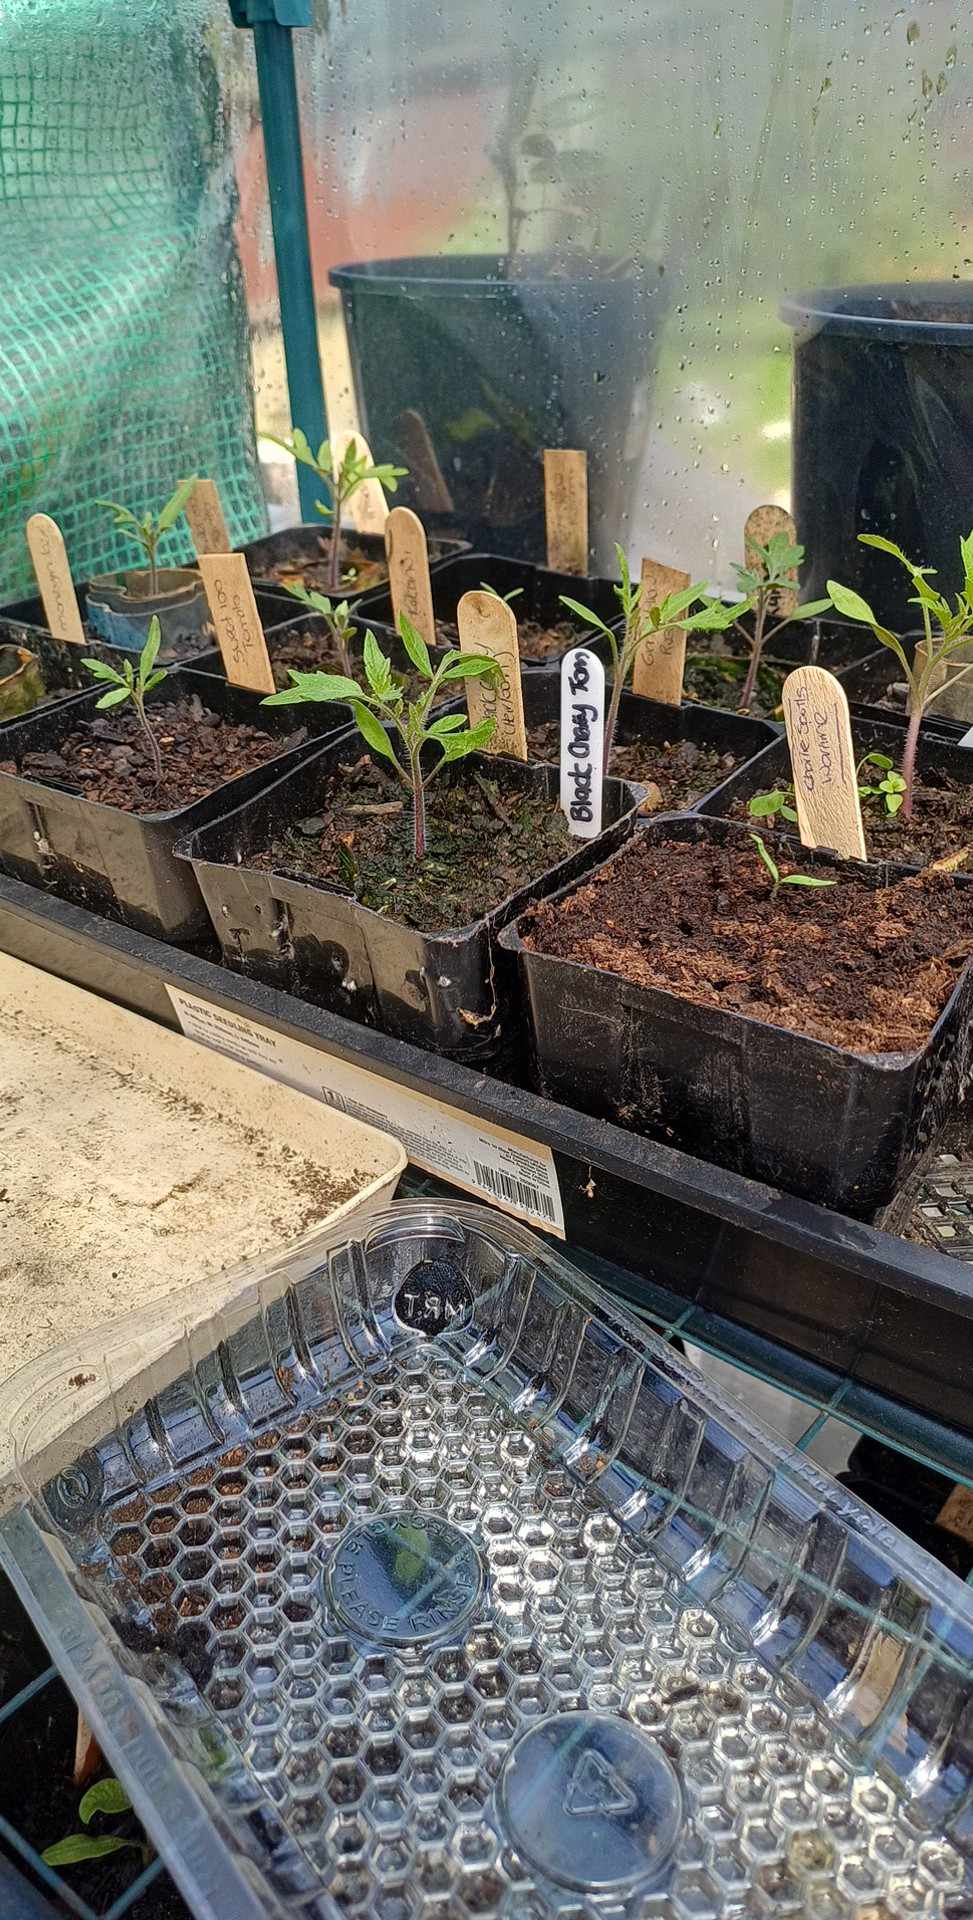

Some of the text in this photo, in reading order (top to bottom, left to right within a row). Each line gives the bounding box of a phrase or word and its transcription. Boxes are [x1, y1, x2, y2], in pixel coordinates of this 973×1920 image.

[567, 762, 594, 823] Black
[178, 996, 213, 1019] PLASTIC
[253, 1030, 277, 1048] TRAY
[338, 1563, 400, 1633] PLEASE
[408, 1565, 473, 1633] RINSE
